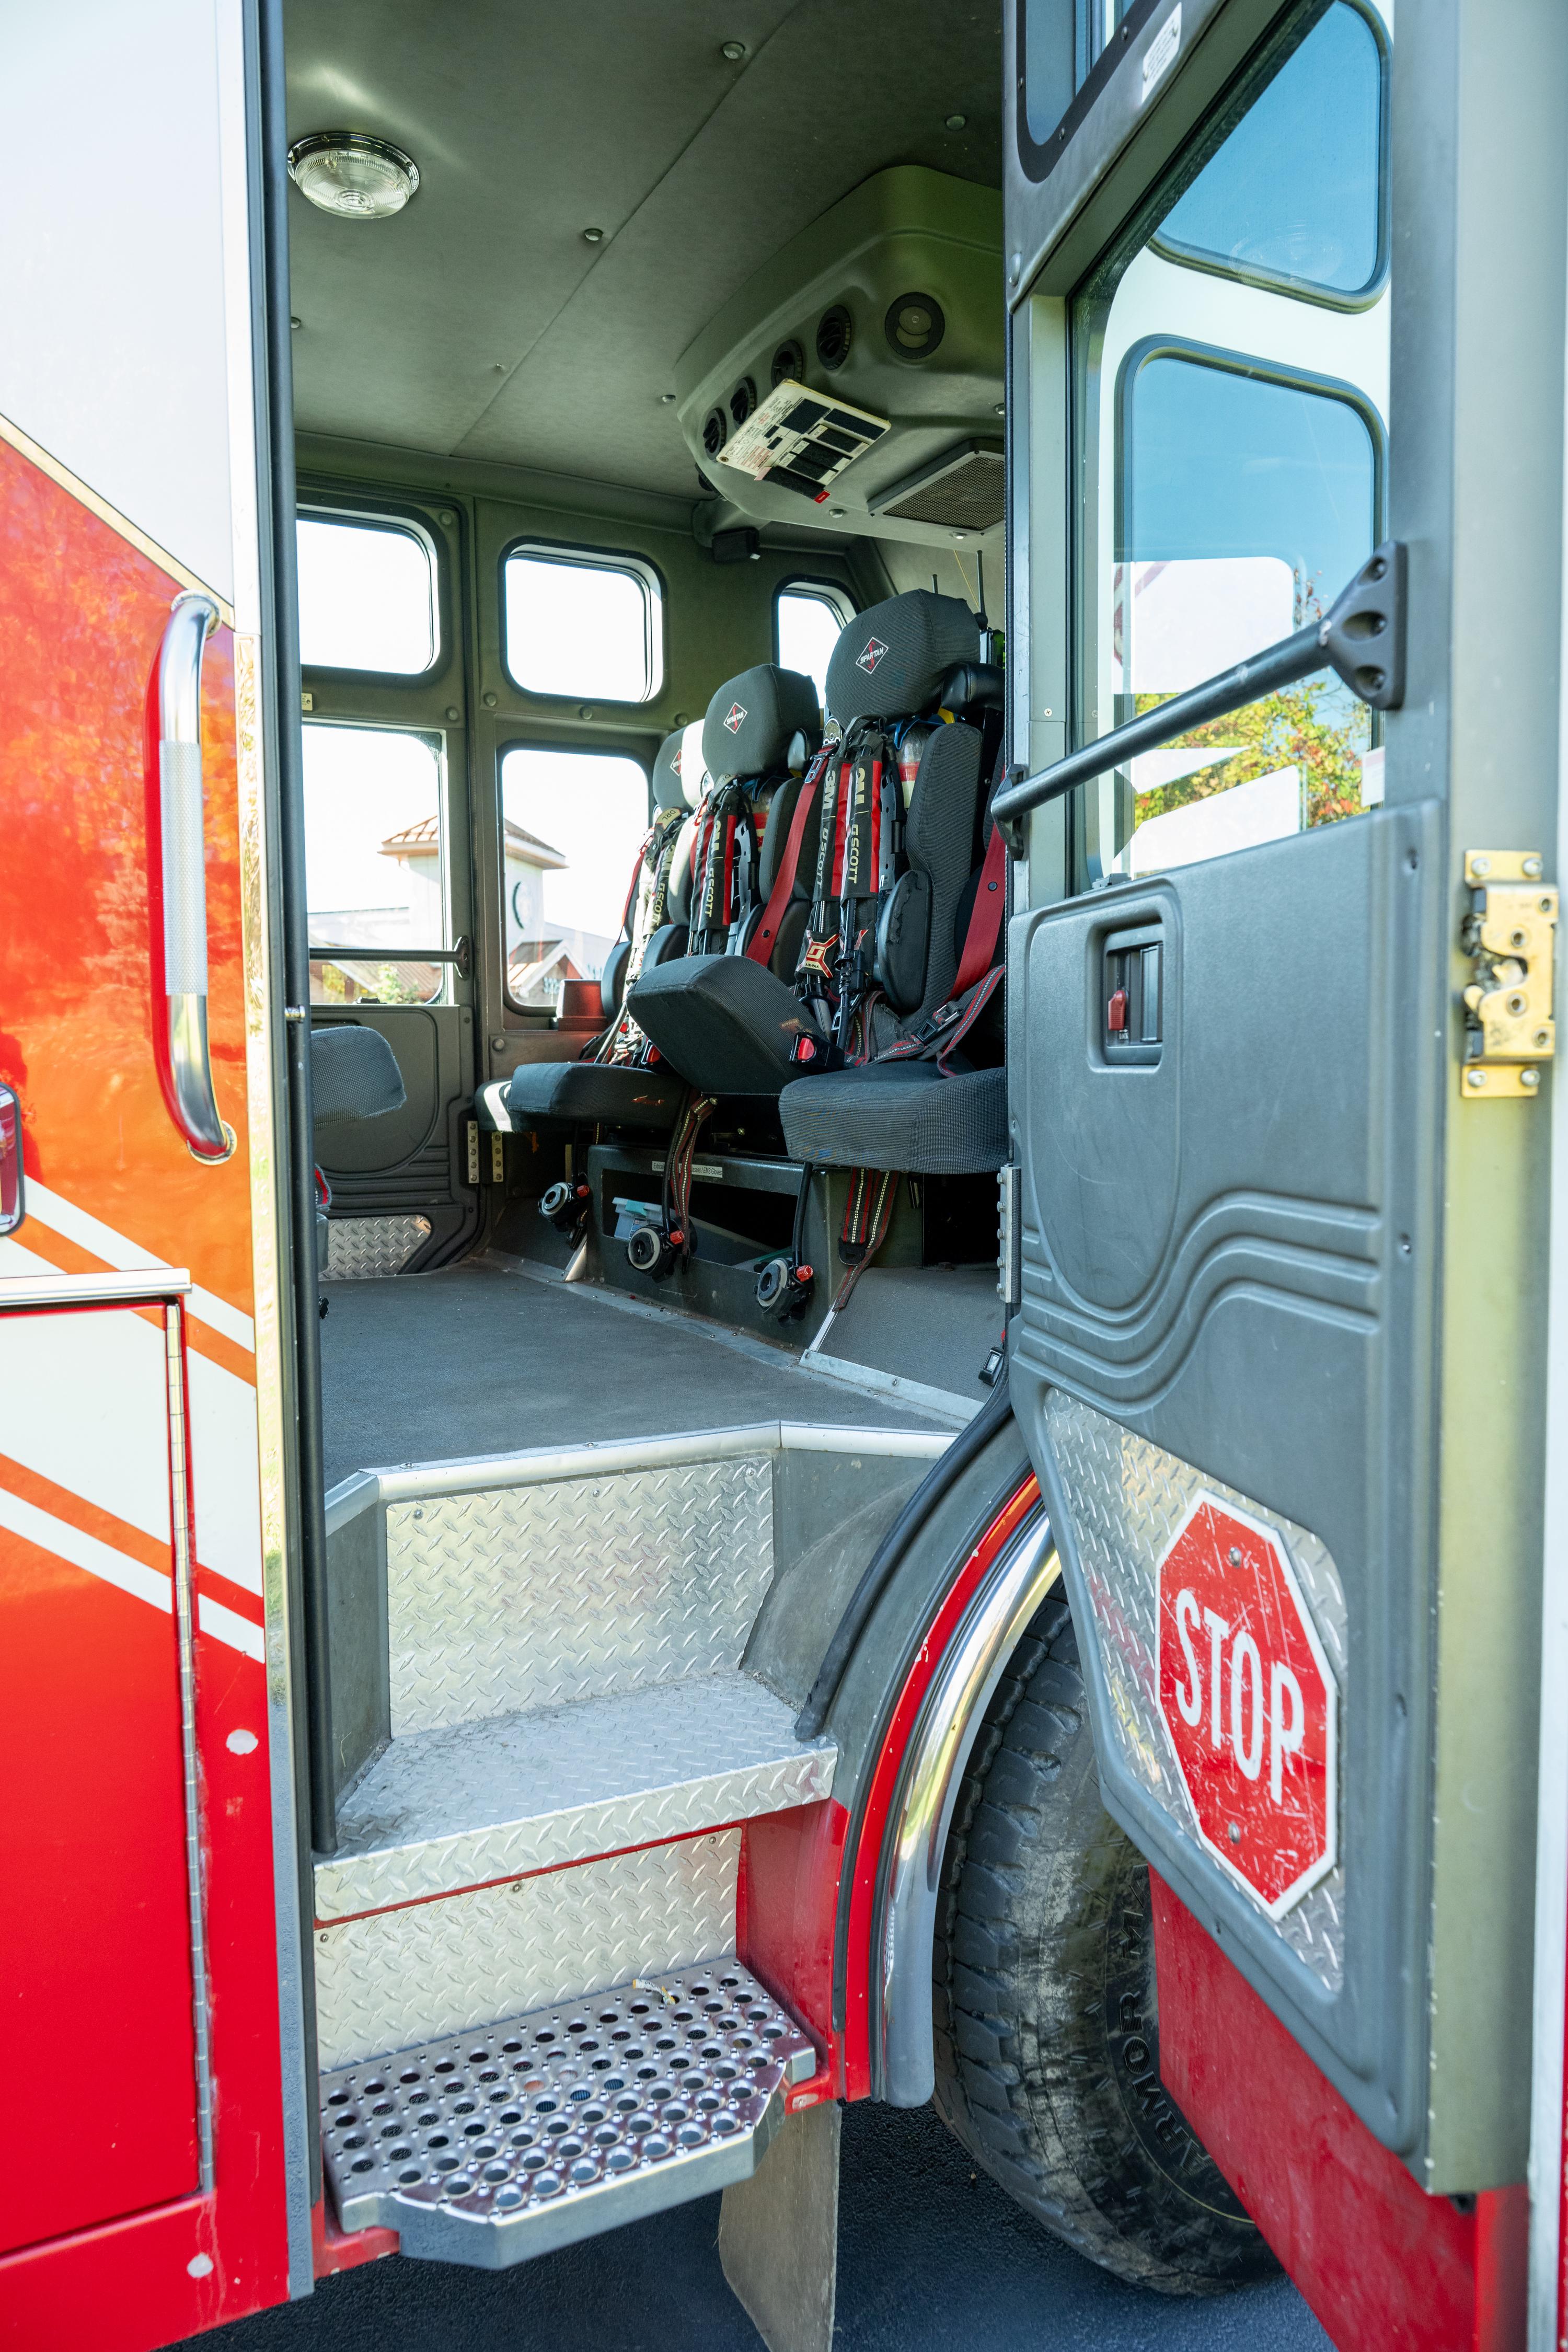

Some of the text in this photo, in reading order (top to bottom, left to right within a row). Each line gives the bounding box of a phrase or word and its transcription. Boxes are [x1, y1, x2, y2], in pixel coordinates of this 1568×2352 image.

[860, 647, 884, 664] SPARTAN
[727, 711, 744, 725] SPARTAN
[662, 810, 676, 820] DRL
[816, 769, 836, 889] 3M SCOTT
[848, 837, 859, 884] SCOTT
[705, 878, 714, 918] SCOTT
[1175, 1588, 1306, 1807] STOP
[1119, 1863, 1149, 1962] MA
